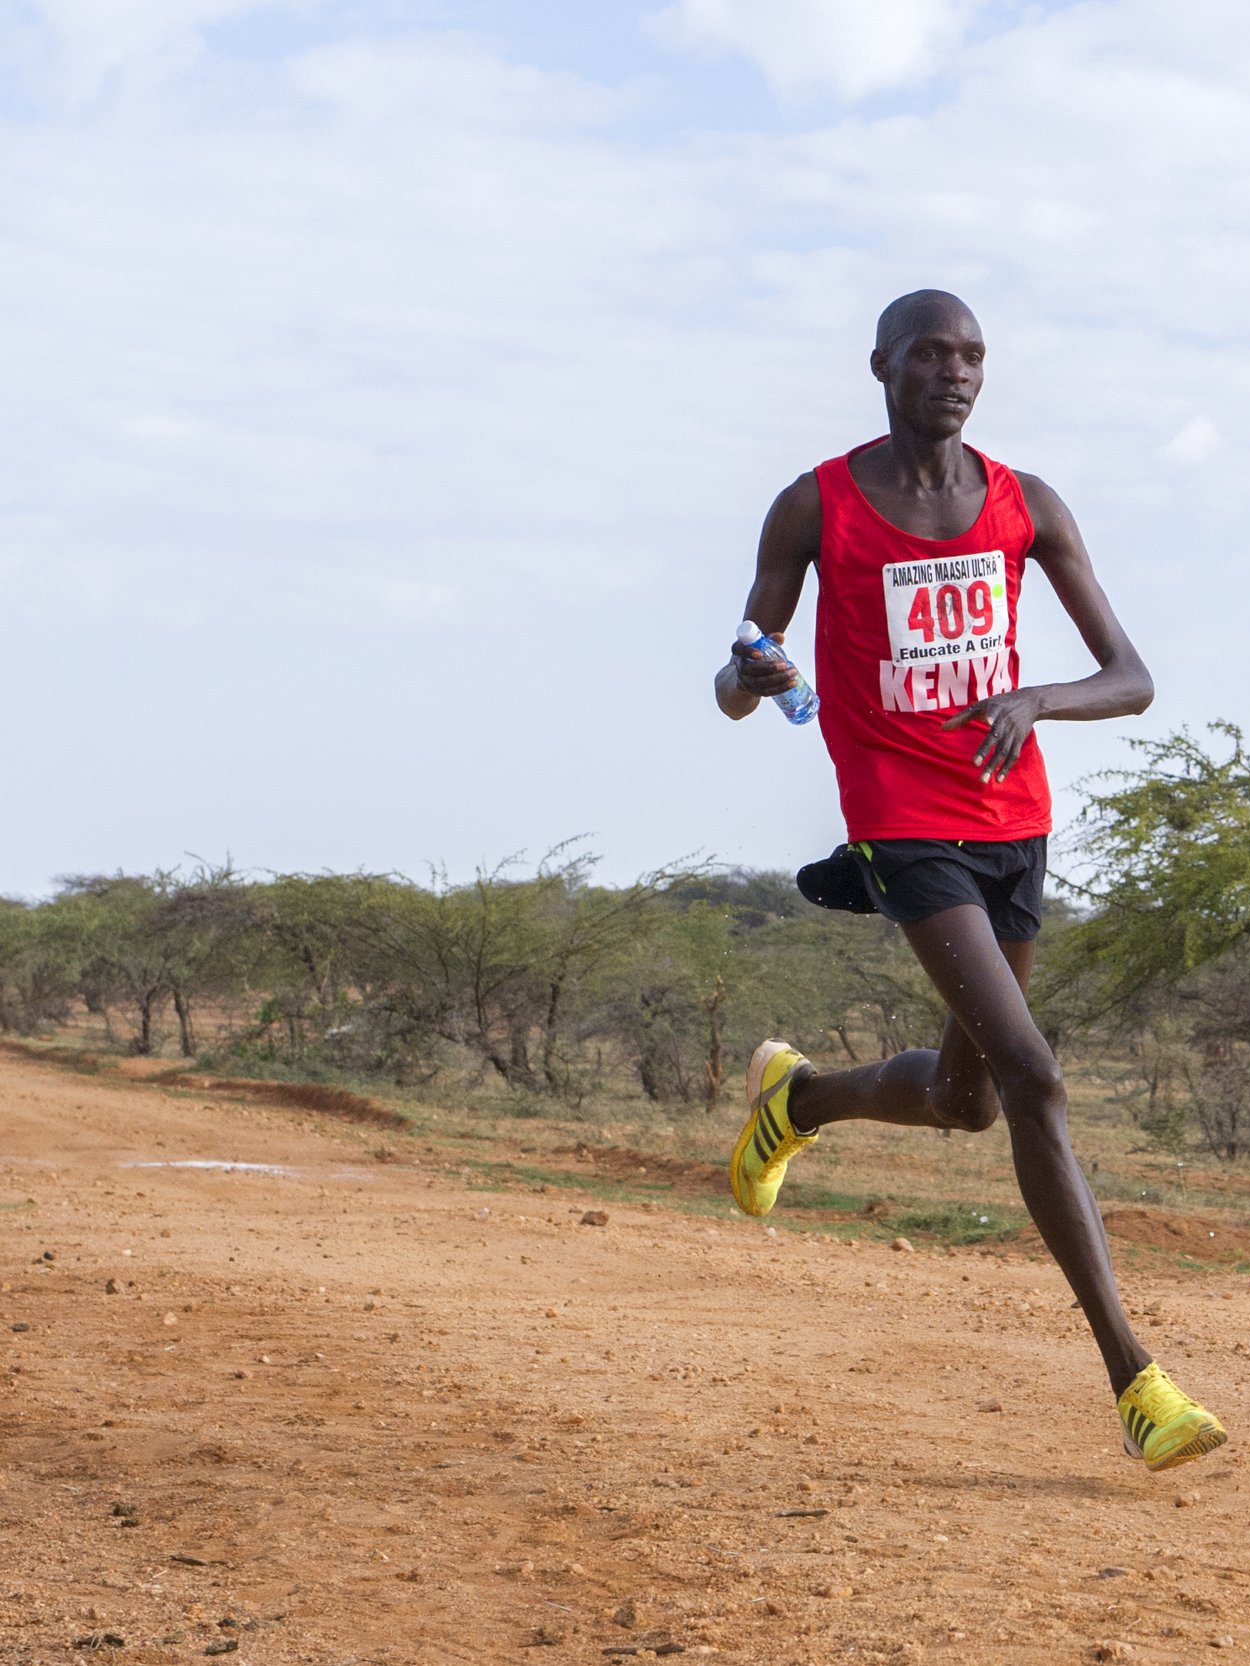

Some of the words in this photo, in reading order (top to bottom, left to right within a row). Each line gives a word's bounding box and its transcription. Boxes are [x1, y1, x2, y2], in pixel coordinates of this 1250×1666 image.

[893, 563, 933, 587] AMAZING
[935, 559, 970, 582] MAASAI
[908, 580, 993, 642] 409
[900, 643, 961, 660] Educate
[965, 640, 976, 652] A
[980, 635, 1002, 650] Girl
[879, 647, 1012, 712] KENYA
